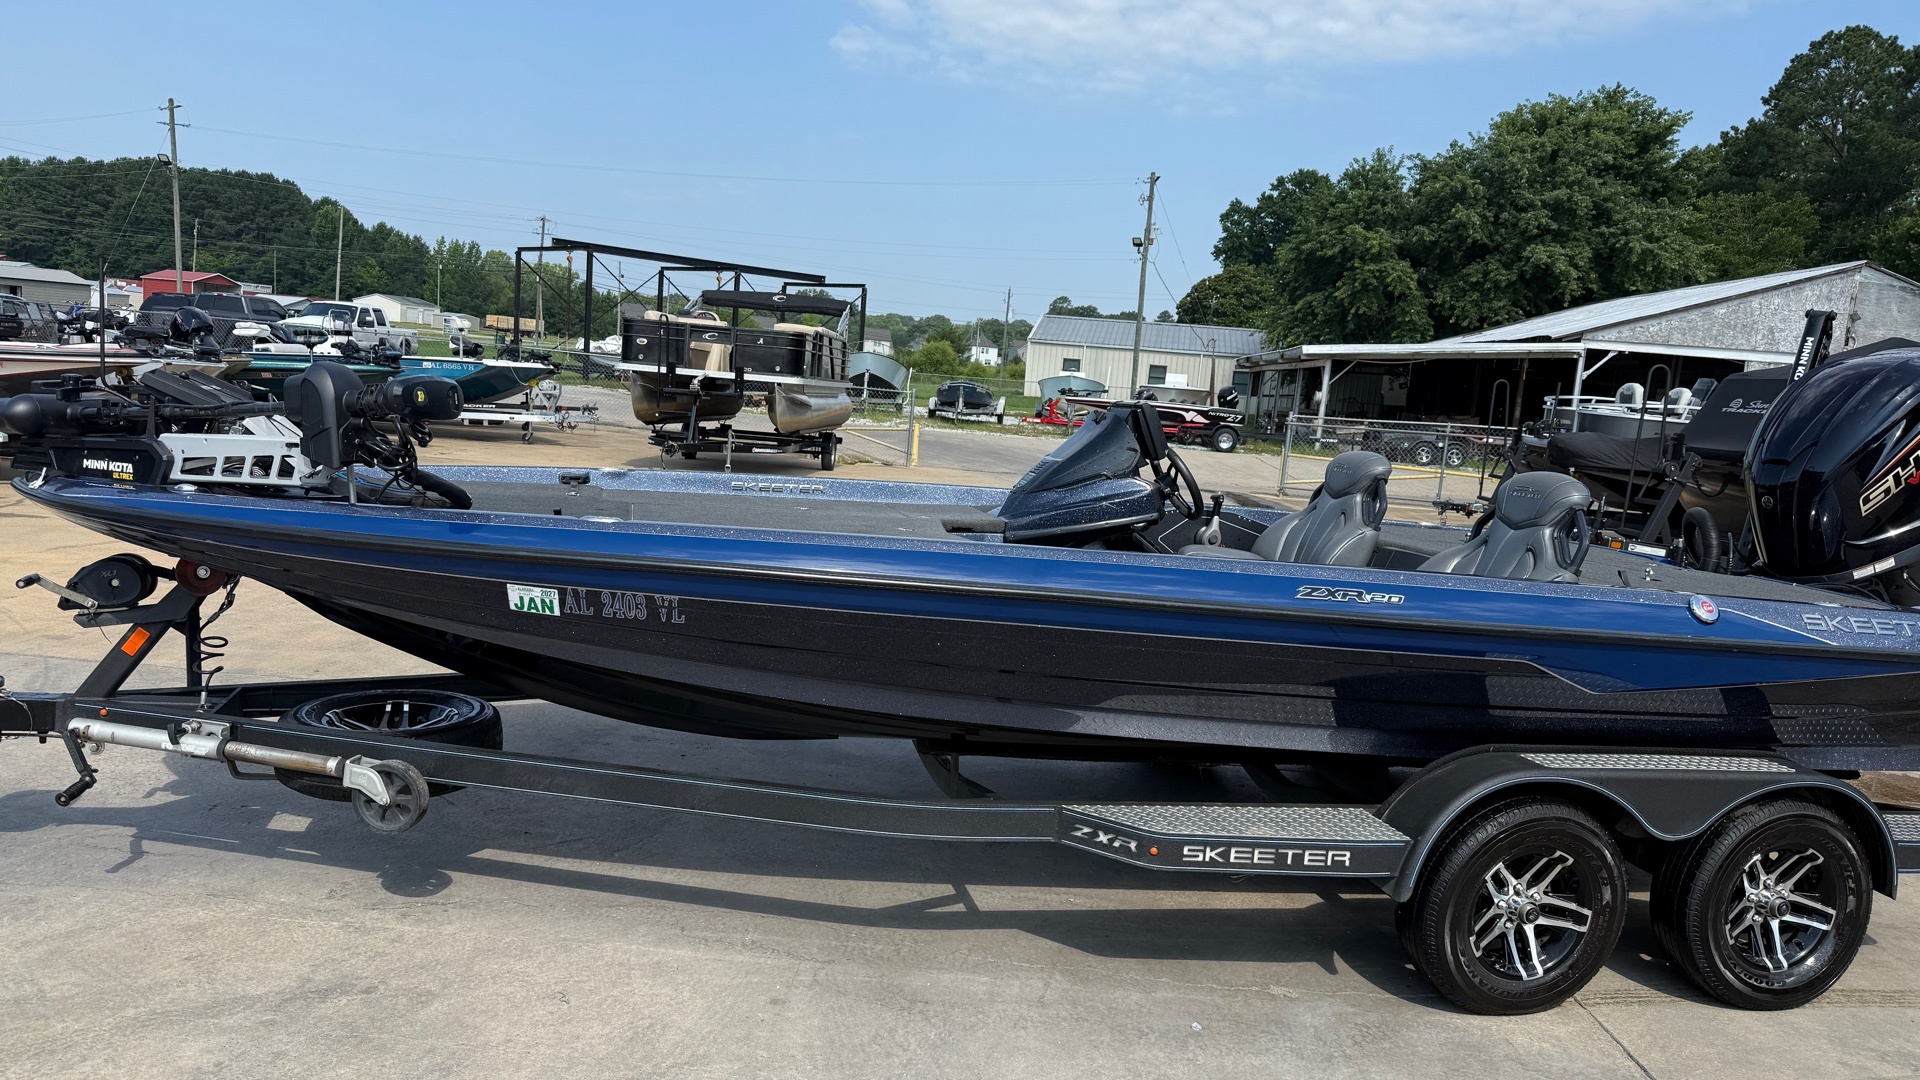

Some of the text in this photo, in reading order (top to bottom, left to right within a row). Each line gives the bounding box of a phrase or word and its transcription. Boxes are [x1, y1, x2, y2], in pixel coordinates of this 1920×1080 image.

[1794, 337, 1814, 380] MINN KO
[83, 459, 133, 473] MINN KOTA
[113, 472, 133, 480] ULTREX
[731, 482, 825, 494] SKEETER
[1860, 450, 1920, 517] SH
[514, 595, 555, 614] JAN
[564, 588, 594, 616] AL
[601, 591, 647, 620] 2403
[1295, 585, 1405, 604] ZXR 20
[1801, 613, 1920, 637] SKEET
[1069, 824, 1138, 852] ZXR
[1182, 845, 1351, 867] SKEETER
